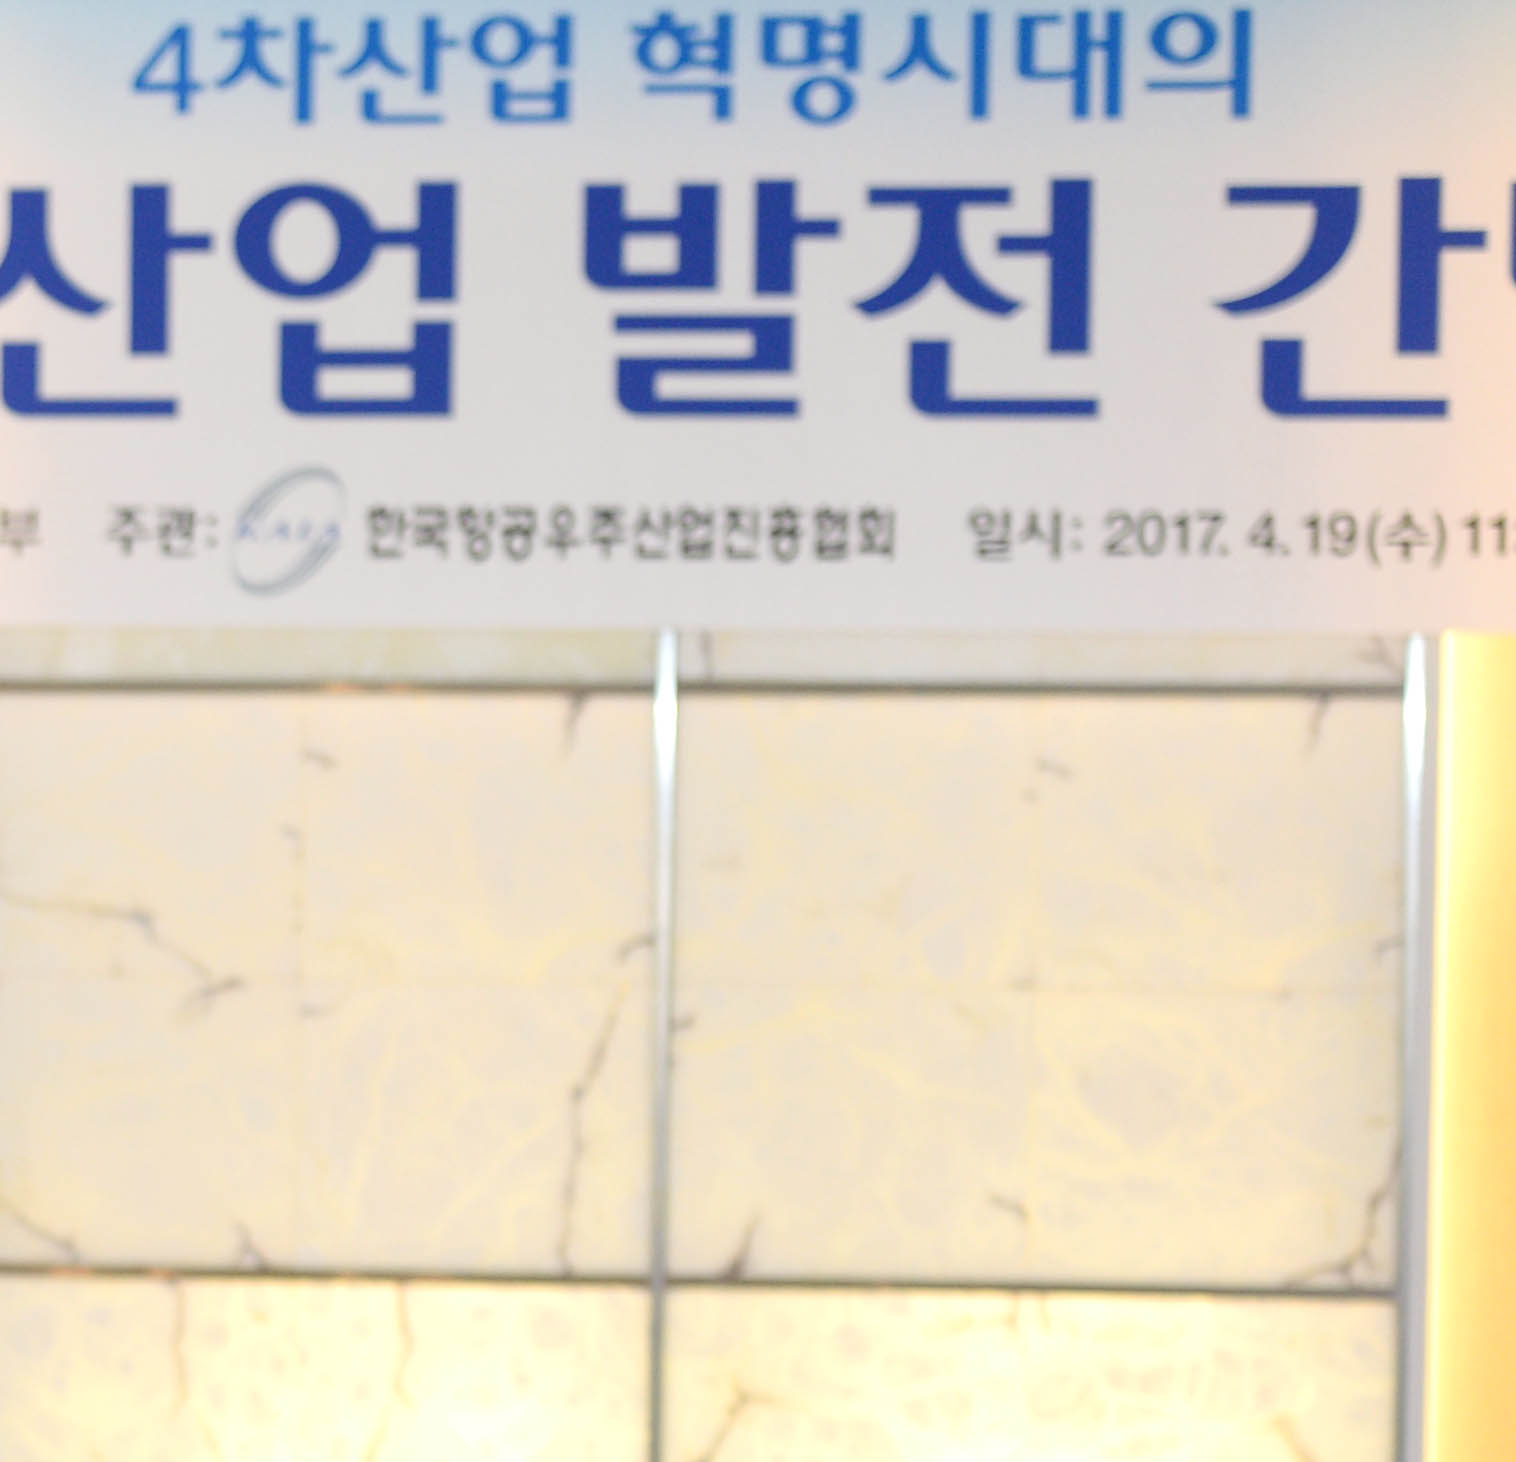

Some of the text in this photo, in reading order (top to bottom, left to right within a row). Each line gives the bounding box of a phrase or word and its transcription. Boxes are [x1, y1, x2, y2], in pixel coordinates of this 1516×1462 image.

[130, 5, 1255, 128] 4차산업 혁명시대의
[581, 177, 1101, 420] 발전
[1214, 176, 1516, 420] 간
[106, 504, 218, 559] 주관:
[364, 503, 898, 563] 한국항공우주산업진흥협회
[966, 506, 1084, 562] 일시:
